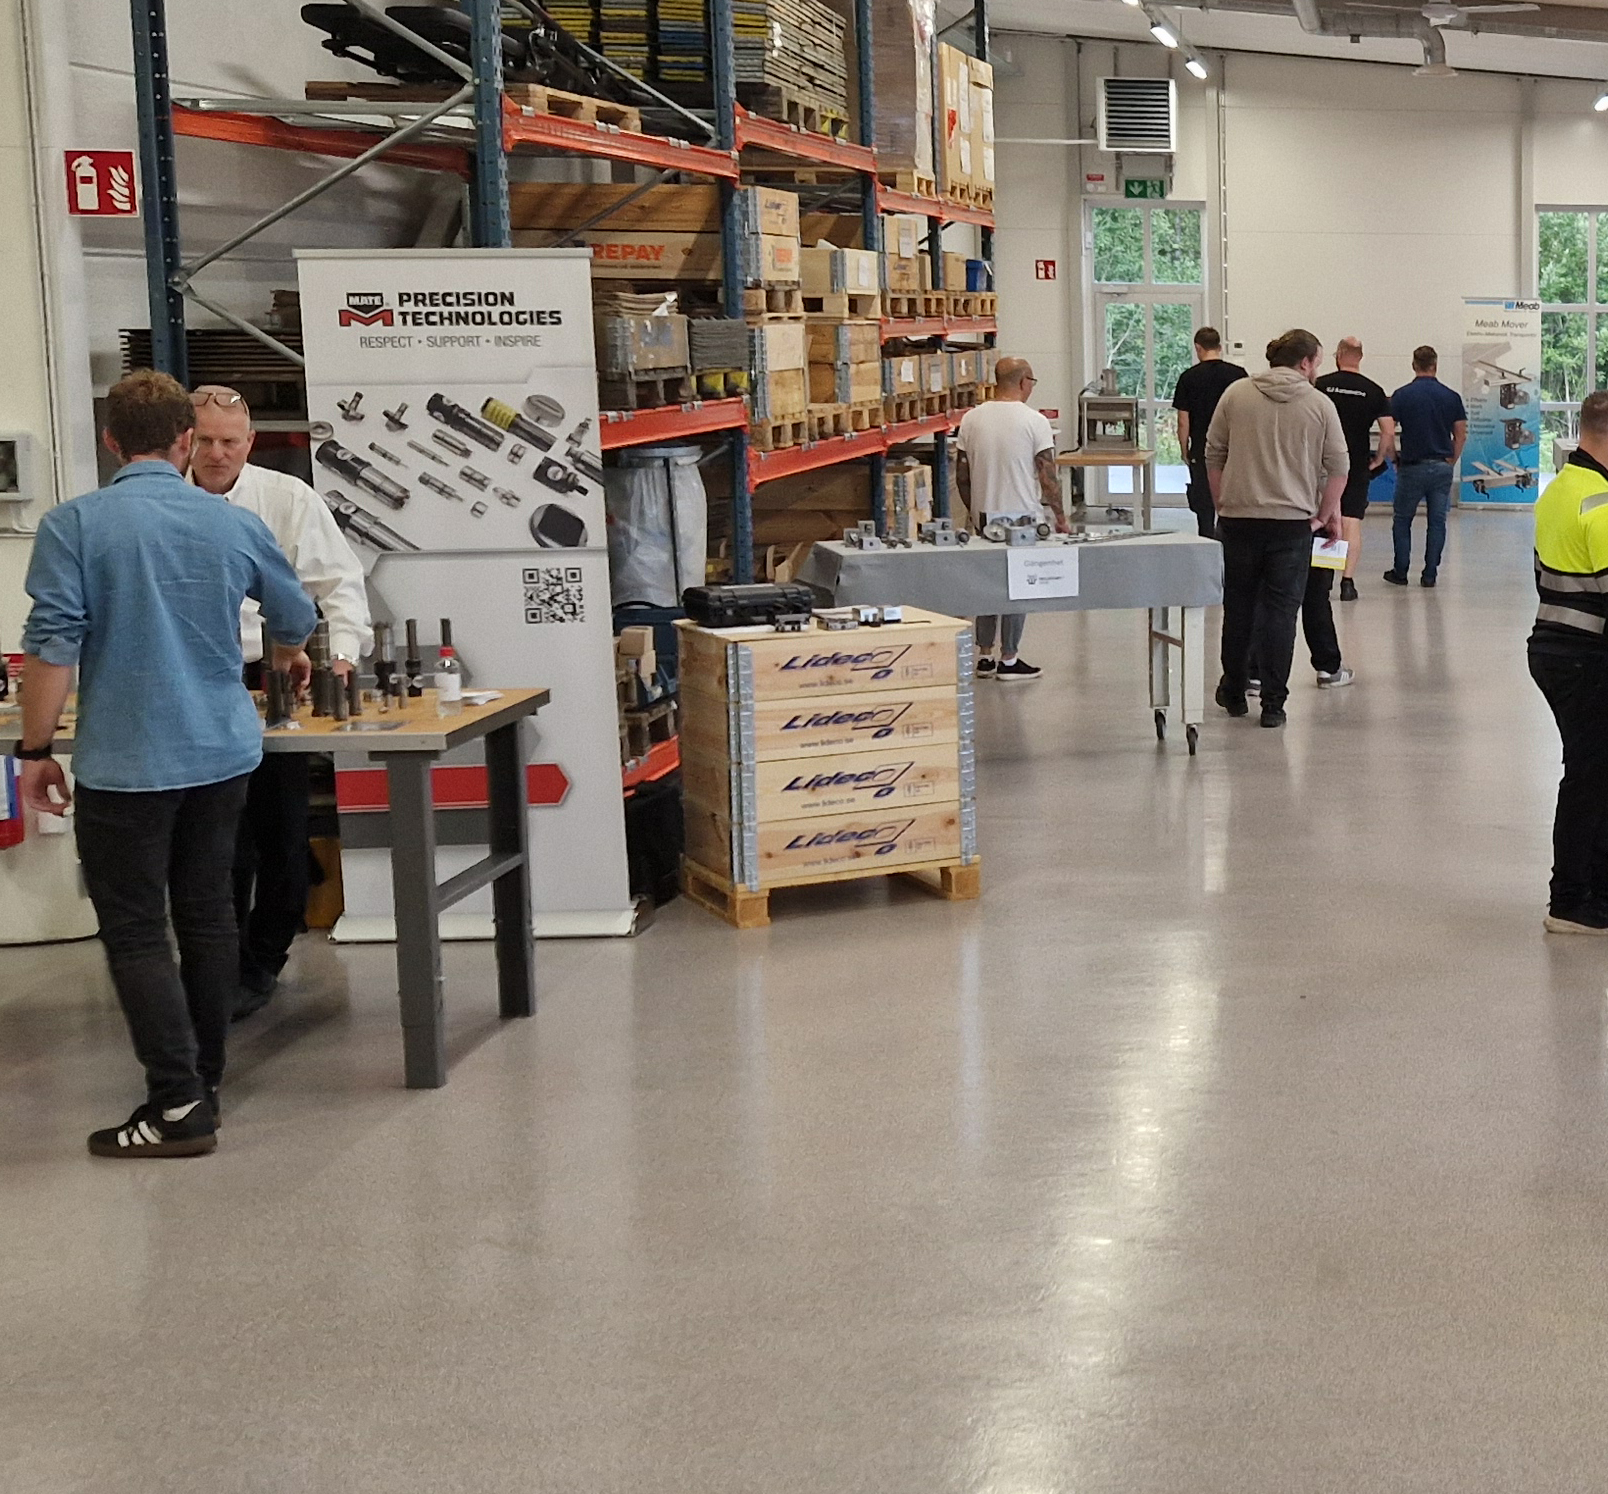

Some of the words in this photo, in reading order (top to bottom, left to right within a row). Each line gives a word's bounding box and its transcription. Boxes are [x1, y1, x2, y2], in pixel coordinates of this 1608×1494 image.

[348, 295, 383, 306] MATE
[398, 291, 515, 308] PRECISION
[1515, 301, 1540, 311] Meab
[398, 310, 562, 327] TECHNOLOGIES
[1475, 318, 1499, 329] Meab
[1501, 319, 1529, 329] Mover
[359, 336, 414, 349] RESPECT
[426, 335, 481, 348] SUPPORT
[494, 335, 542, 348] INSPIRE
